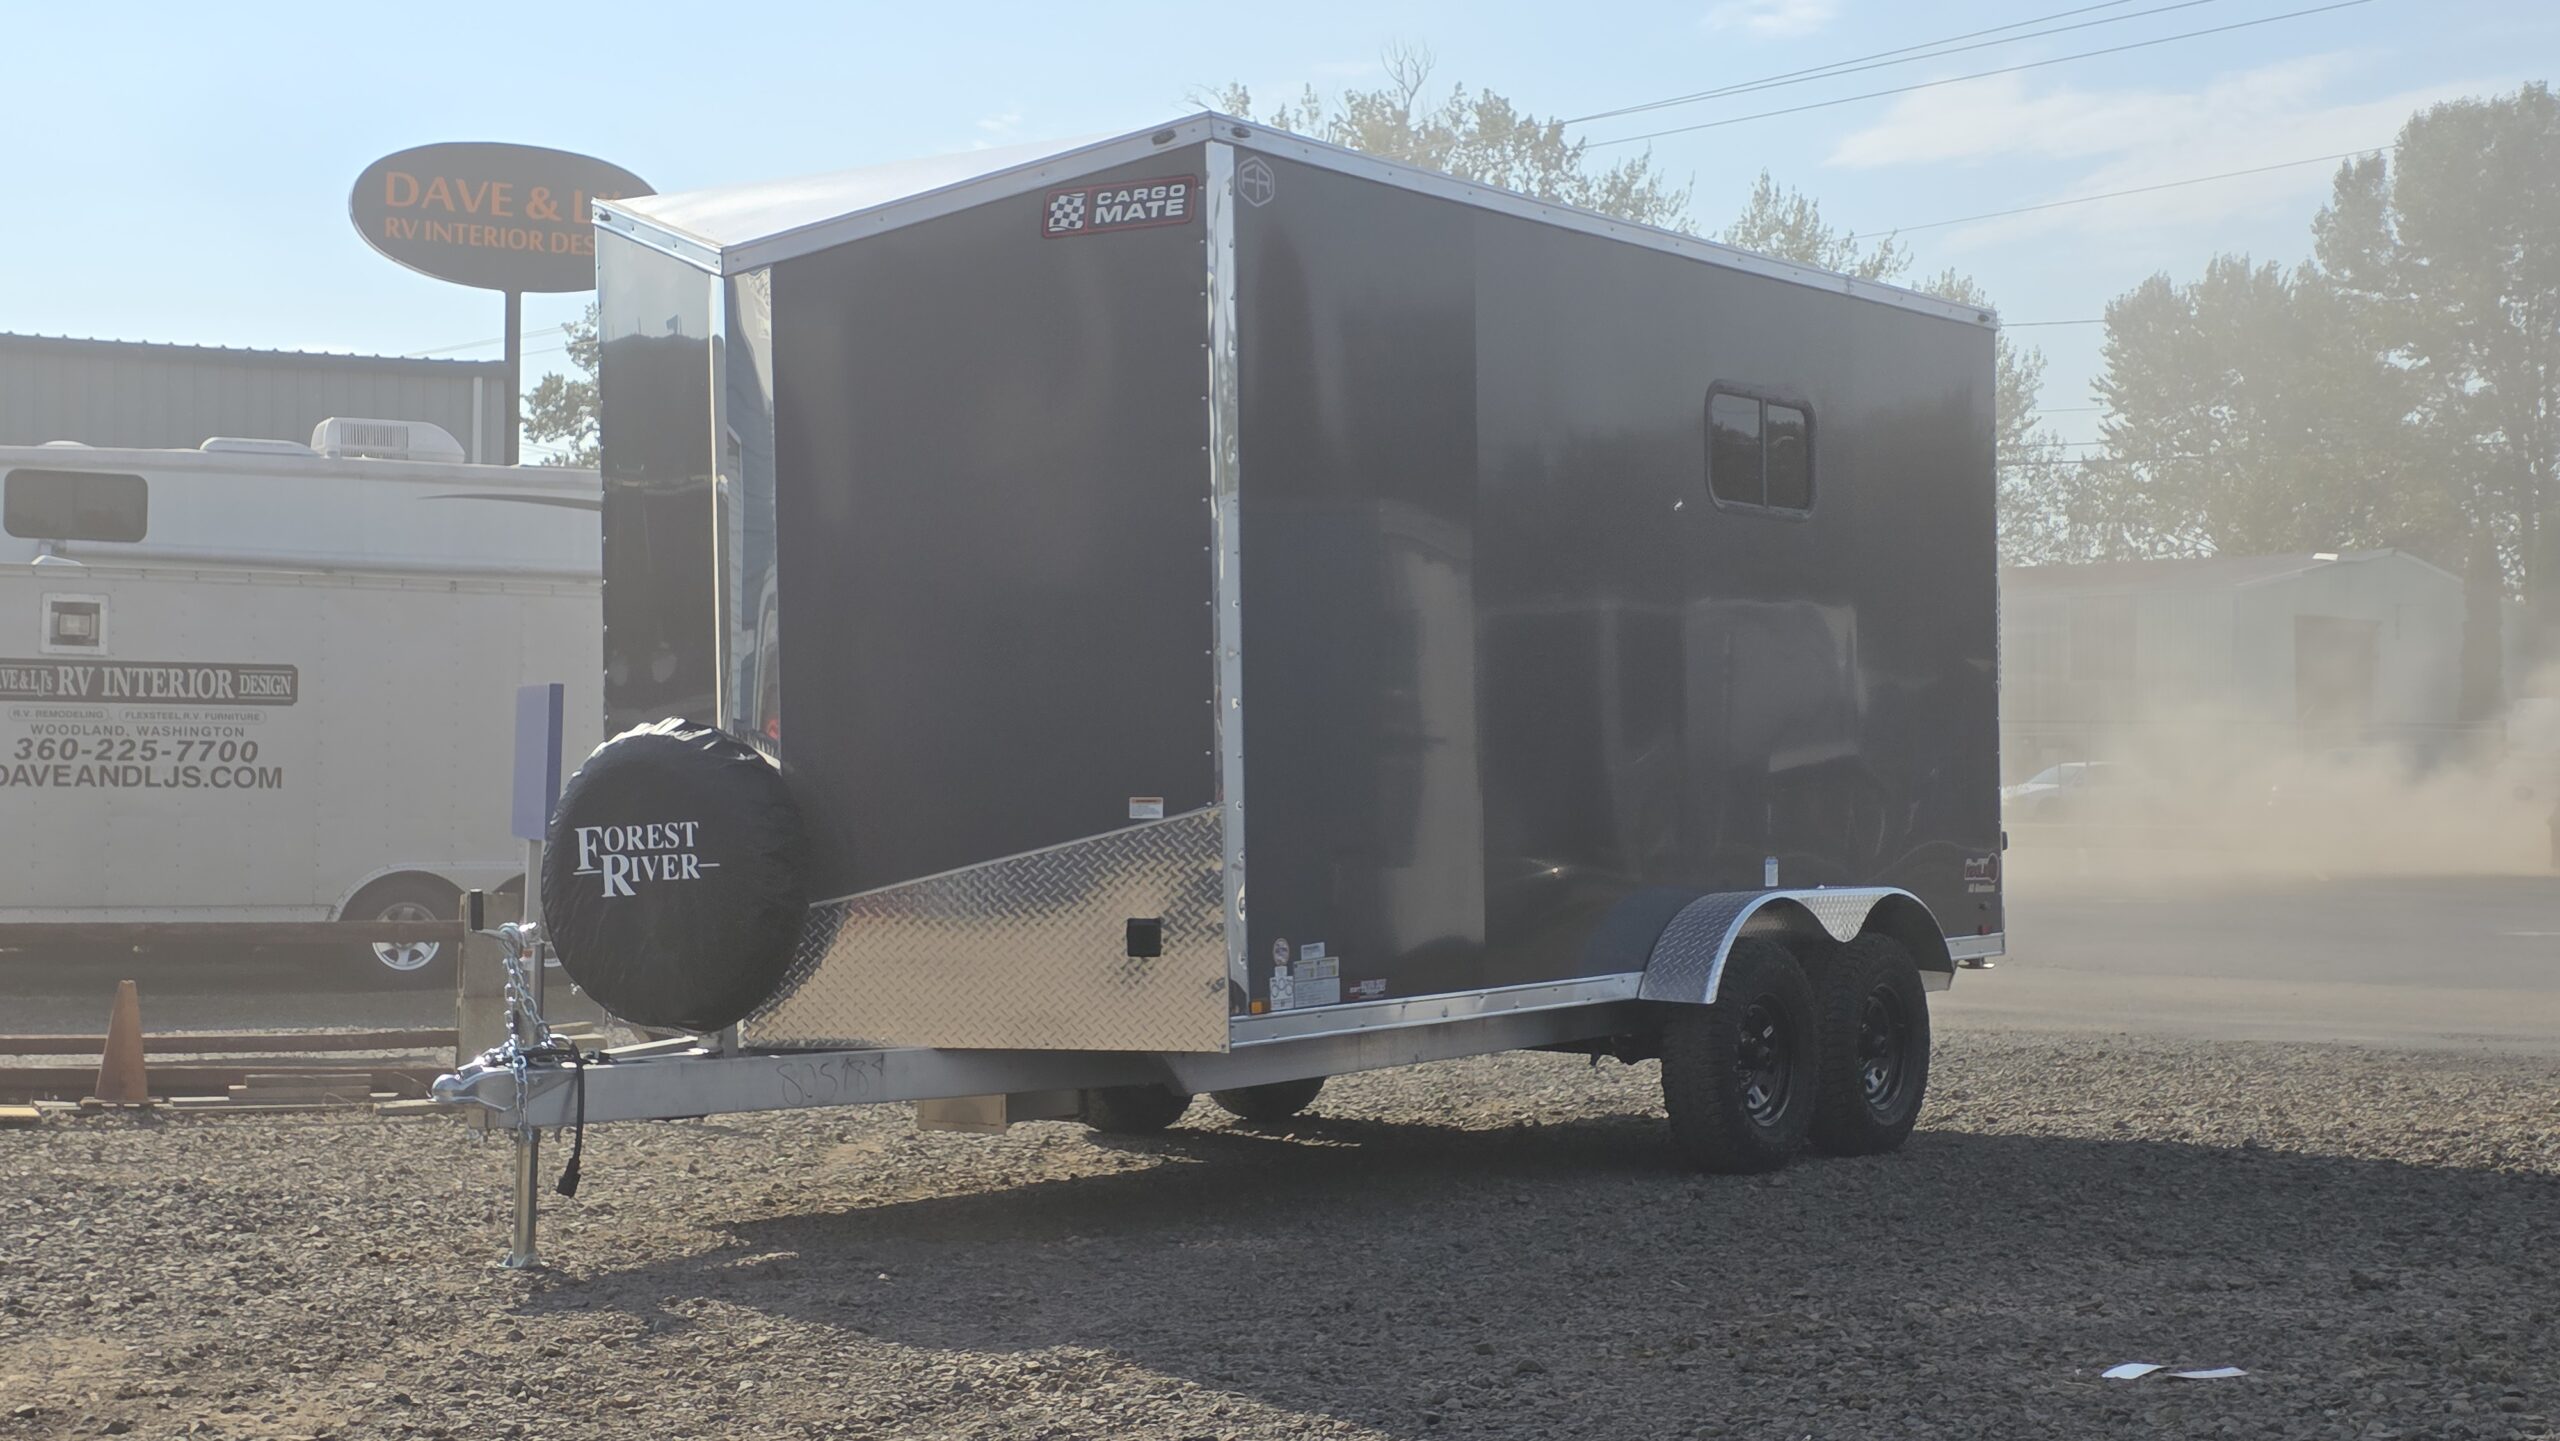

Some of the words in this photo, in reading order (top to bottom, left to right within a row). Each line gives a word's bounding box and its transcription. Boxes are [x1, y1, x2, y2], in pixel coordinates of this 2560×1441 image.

[385, 171, 513, 218] DAVE
[526, 186, 562, 222] &
[1096, 184, 1186, 206] CARGO
[1094, 198, 1185, 225] MATE
[385, 216, 419, 241] RV
[424, 220, 545, 251] INTERIOR
[551, 231, 594, 257] DES
[56, 665, 95, 696] RV
[101, 666, 236, 699] INTERIOR
[239, 674, 292, 695] DESIGN
[34, 709, 104, 719] REMODELING
[204, 712, 261, 722] FURNITURE
[30, 723, 130, 737] WOODLAND,
[136, 725, 245, 738] WASHINGTON
[13, 737, 260, 764] 360-225-7700
[574, 820, 699, 871] FOREST
[600, 852, 701, 898] RIVER
